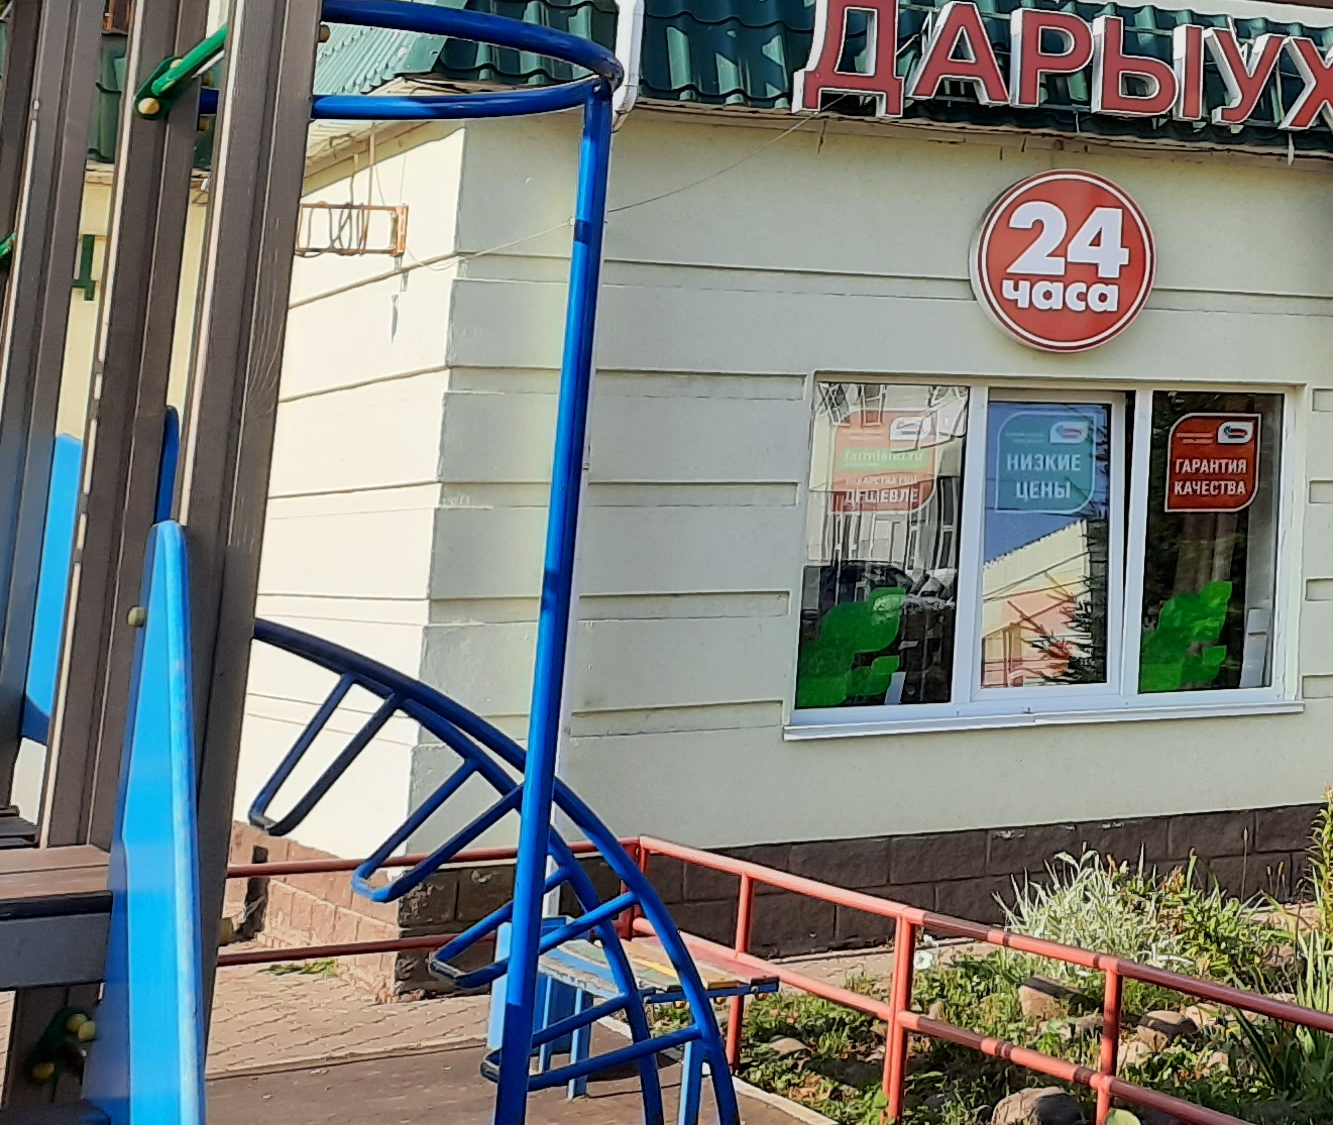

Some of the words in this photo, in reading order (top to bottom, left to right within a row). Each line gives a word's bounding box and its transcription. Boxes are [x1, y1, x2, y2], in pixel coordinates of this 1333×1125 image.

[1006, 200, 1129, 279] 24
[1001, 278, 1119, 312] часа
[1006, 453, 1081, 472] НИЗКИЕ
[1175, 458, 1247, 474] ГАРАНТИЯ
[1015, 481, 1072, 502] ЦЕНЫ
[1173, 480, 1246, 495] КАЧЕСТВА
